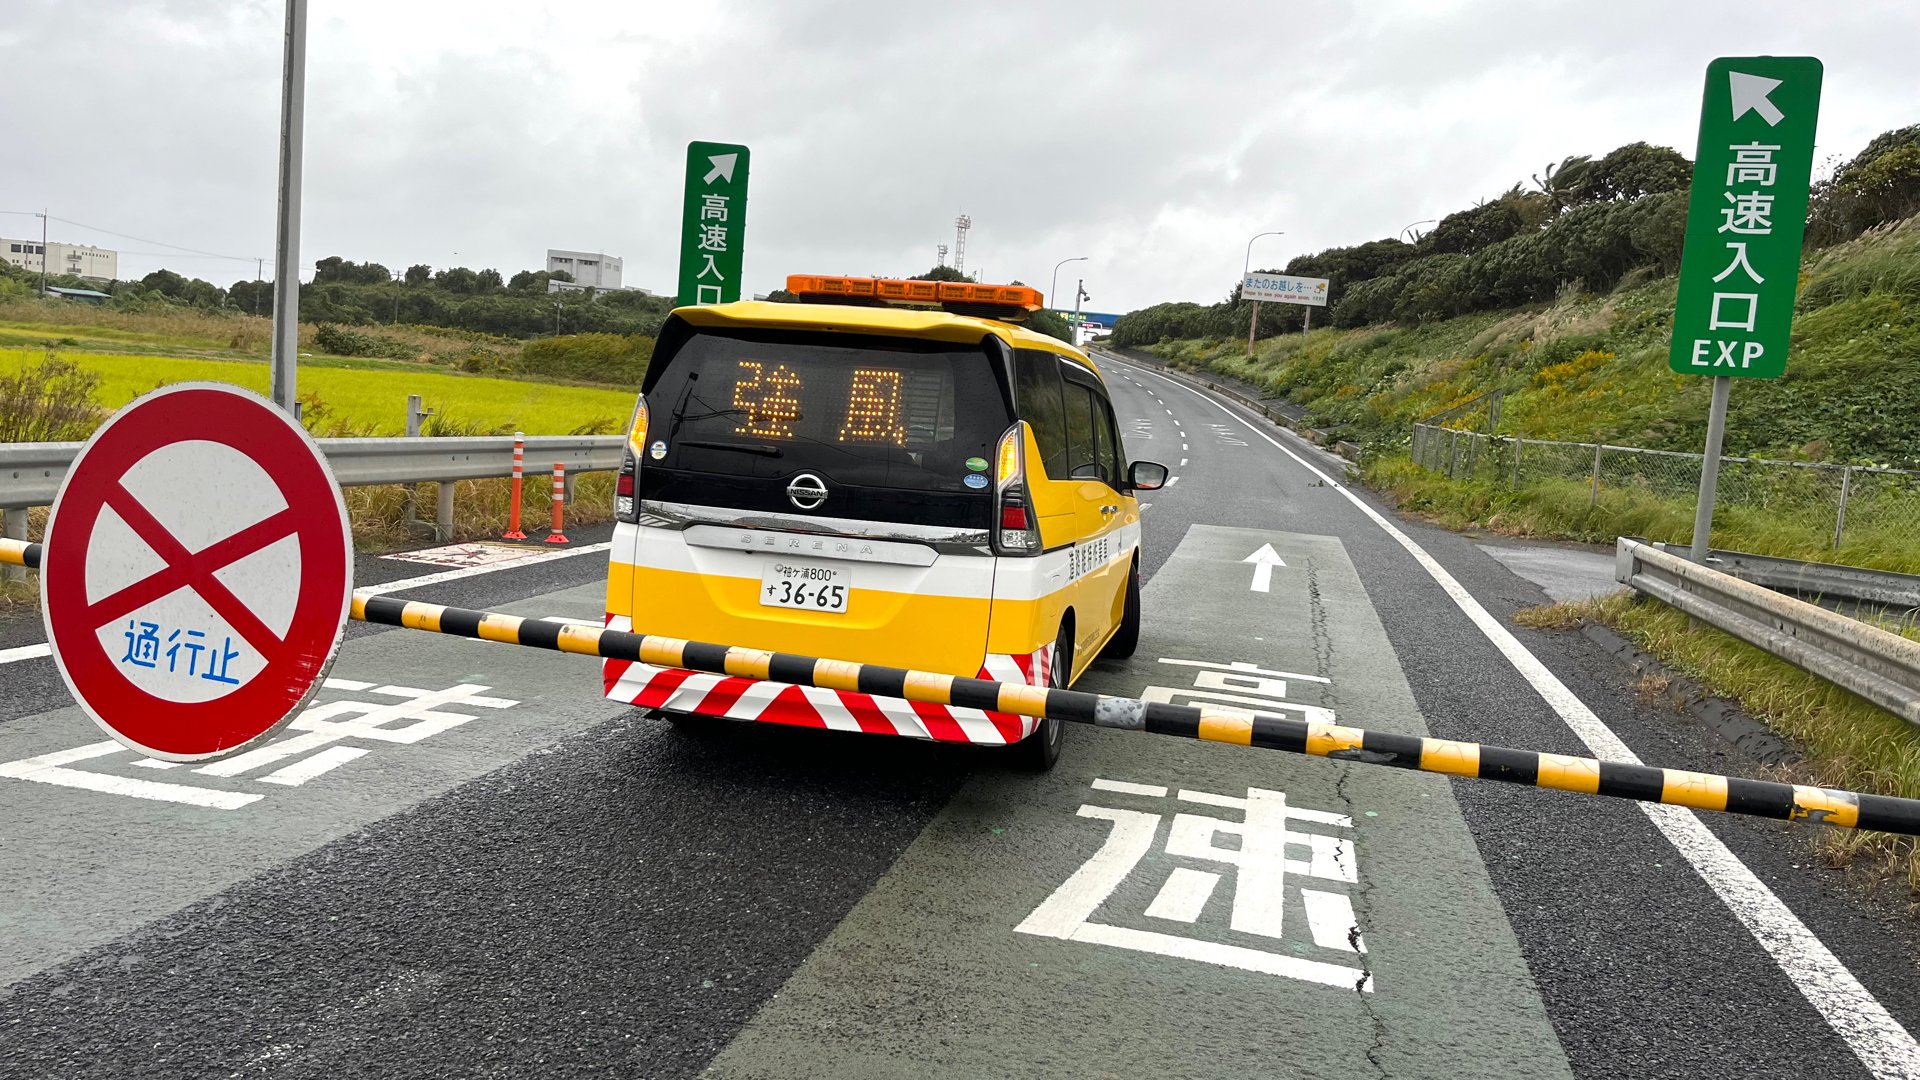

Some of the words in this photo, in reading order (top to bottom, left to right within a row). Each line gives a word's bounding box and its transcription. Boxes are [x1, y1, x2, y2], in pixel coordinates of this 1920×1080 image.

[696, 193, 731, 306] 高速入口
[1709, 140, 1782, 333] 高速入口
[1691, 339, 1765, 369] EXP
[790, 488, 824, 498] NISSAN
[740, 534, 873, 555] SERENA
[779, 580, 845, 609] 36-65
[121, 619, 240, 685] 通行止
